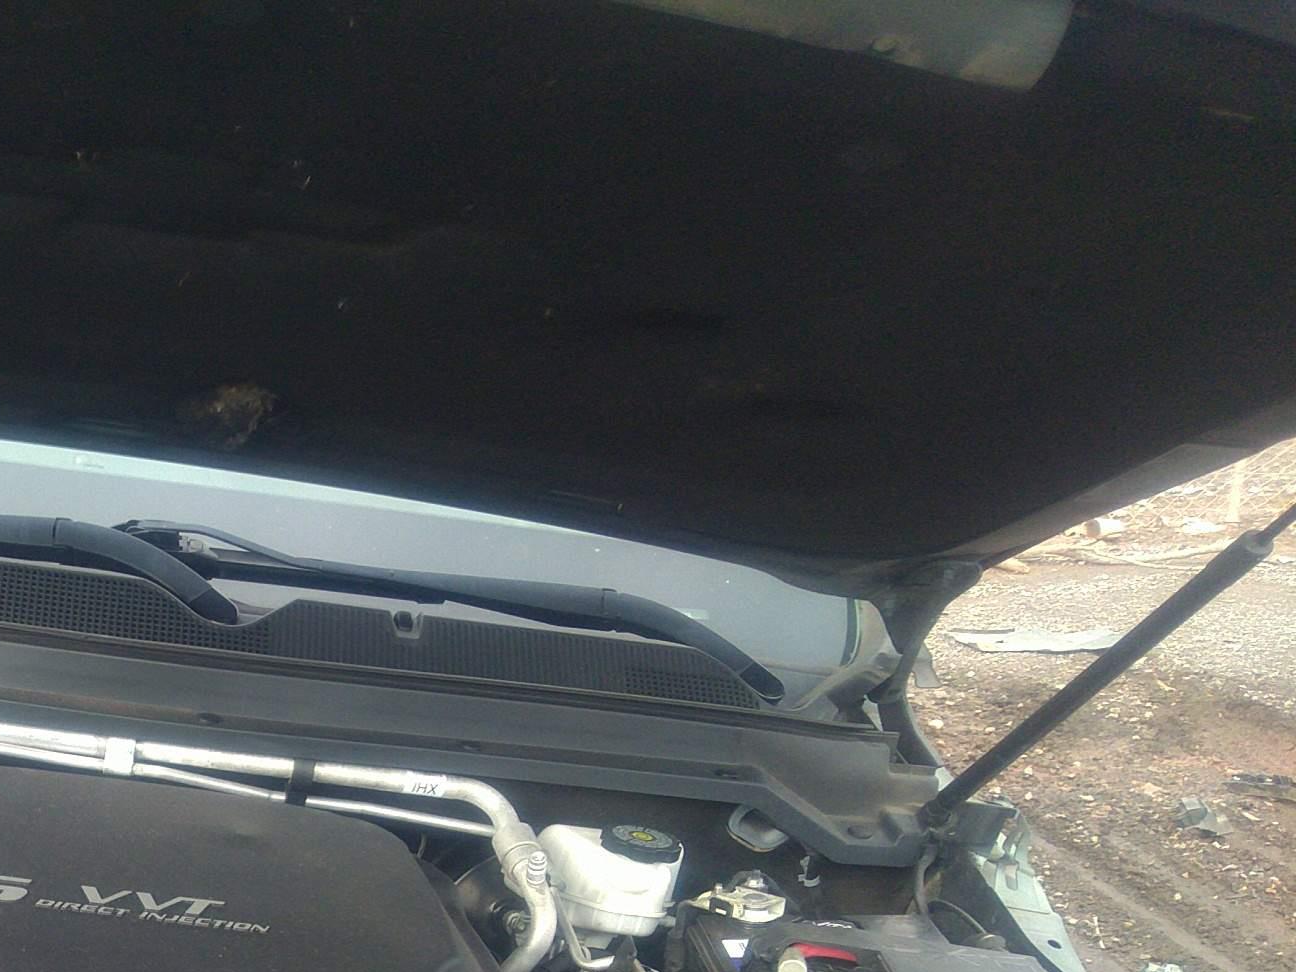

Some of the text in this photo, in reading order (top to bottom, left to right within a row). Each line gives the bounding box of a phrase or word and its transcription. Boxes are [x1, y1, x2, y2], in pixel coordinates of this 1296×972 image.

[34, 897, 272, 934] DIRECT INJECTION
[80, 885, 226, 915] VVT
